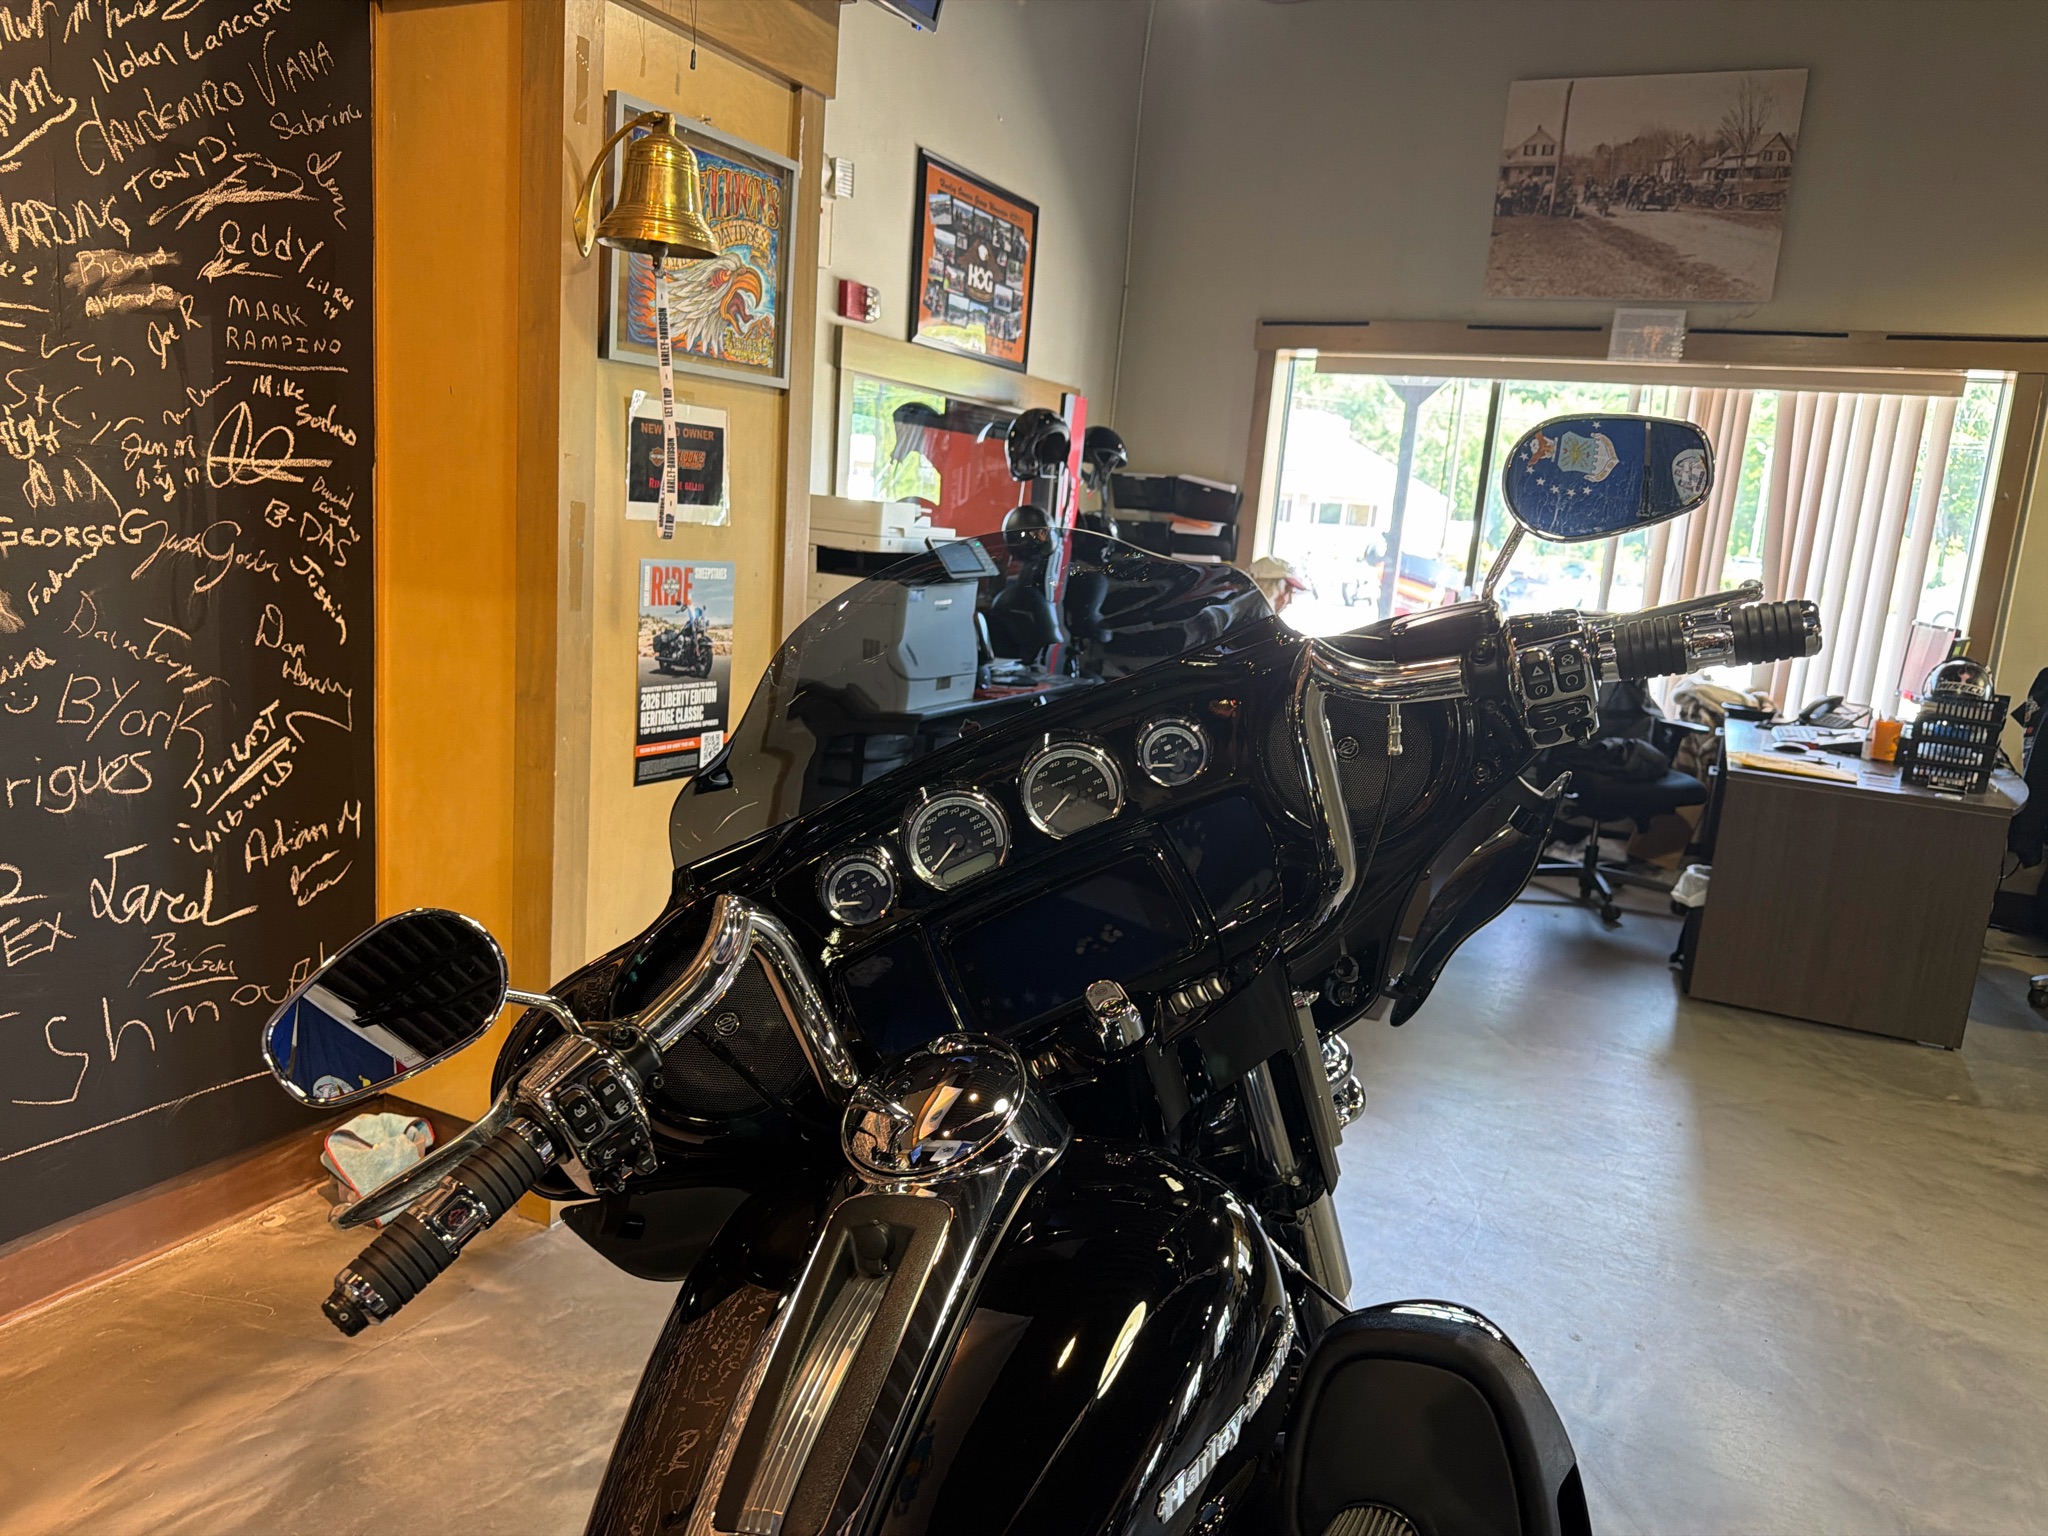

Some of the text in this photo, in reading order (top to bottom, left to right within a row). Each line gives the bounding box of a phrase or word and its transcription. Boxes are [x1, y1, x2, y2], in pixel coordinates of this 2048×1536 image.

[967, 264, 994, 294] HOG
[227, 294, 309, 328] MARK
[226, 326, 342, 355] RAMPINO
[658, 307, 671, 367] HARLEY-DAVIDSON
[640, 421, 664, 436] NEW
[682, 427, 715, 442] OWNER
[666, 437, 676, 494] HARLEY-DAVIDSON
[650, 565, 695, 607] RIDE
[640, 686, 718, 711] 2026 LIBERTY EDITION
[640, 704, 705, 728] HERITAGE CLASSIC
